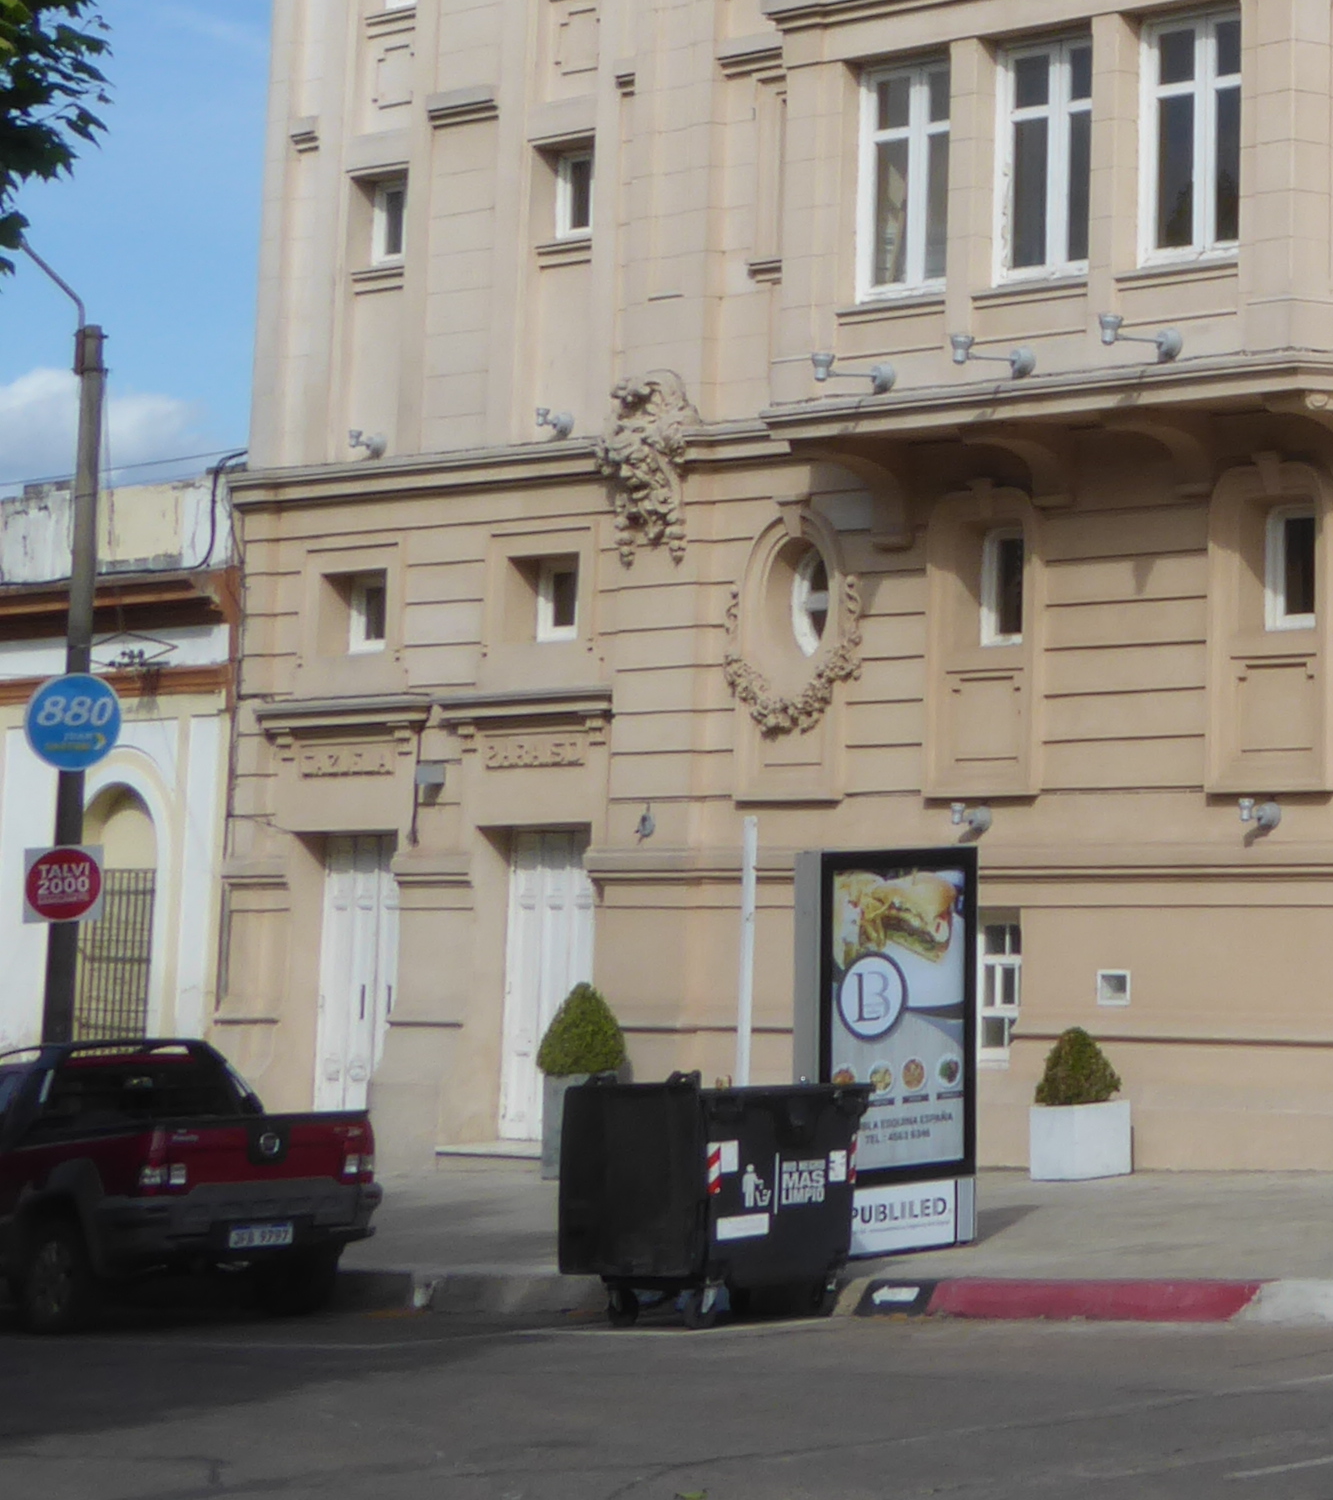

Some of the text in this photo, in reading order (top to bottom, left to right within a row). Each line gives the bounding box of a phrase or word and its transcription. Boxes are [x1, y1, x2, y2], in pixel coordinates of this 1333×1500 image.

[37, 695, 114, 727] 880
[38, 861, 91, 880] TALVI
[37, 876, 91, 895] 2000
[920, 1111, 953, 1125] ESPAÑA
[781, 1170, 826, 1190] MAS
[781, 1186, 826, 1205] LIMPIO
